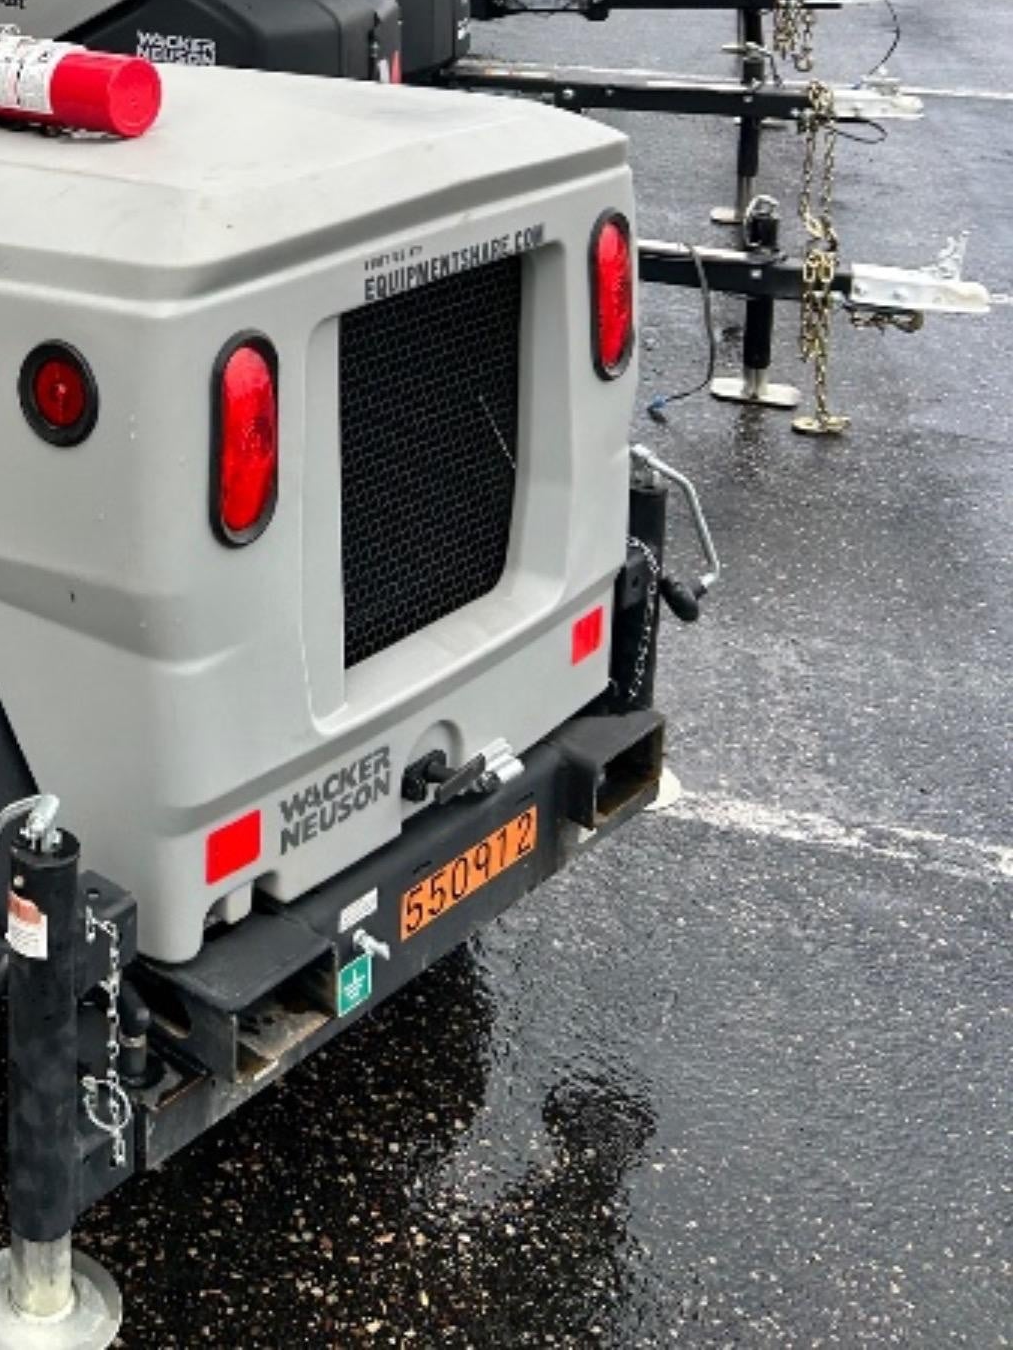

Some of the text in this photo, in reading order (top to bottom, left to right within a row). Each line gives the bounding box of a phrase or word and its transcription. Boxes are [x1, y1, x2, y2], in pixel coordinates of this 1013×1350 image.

[279, 745, 390, 823] WACKER
[280, 769, 390, 856] NEUSON
[405, 812, 532, 933] 550912
